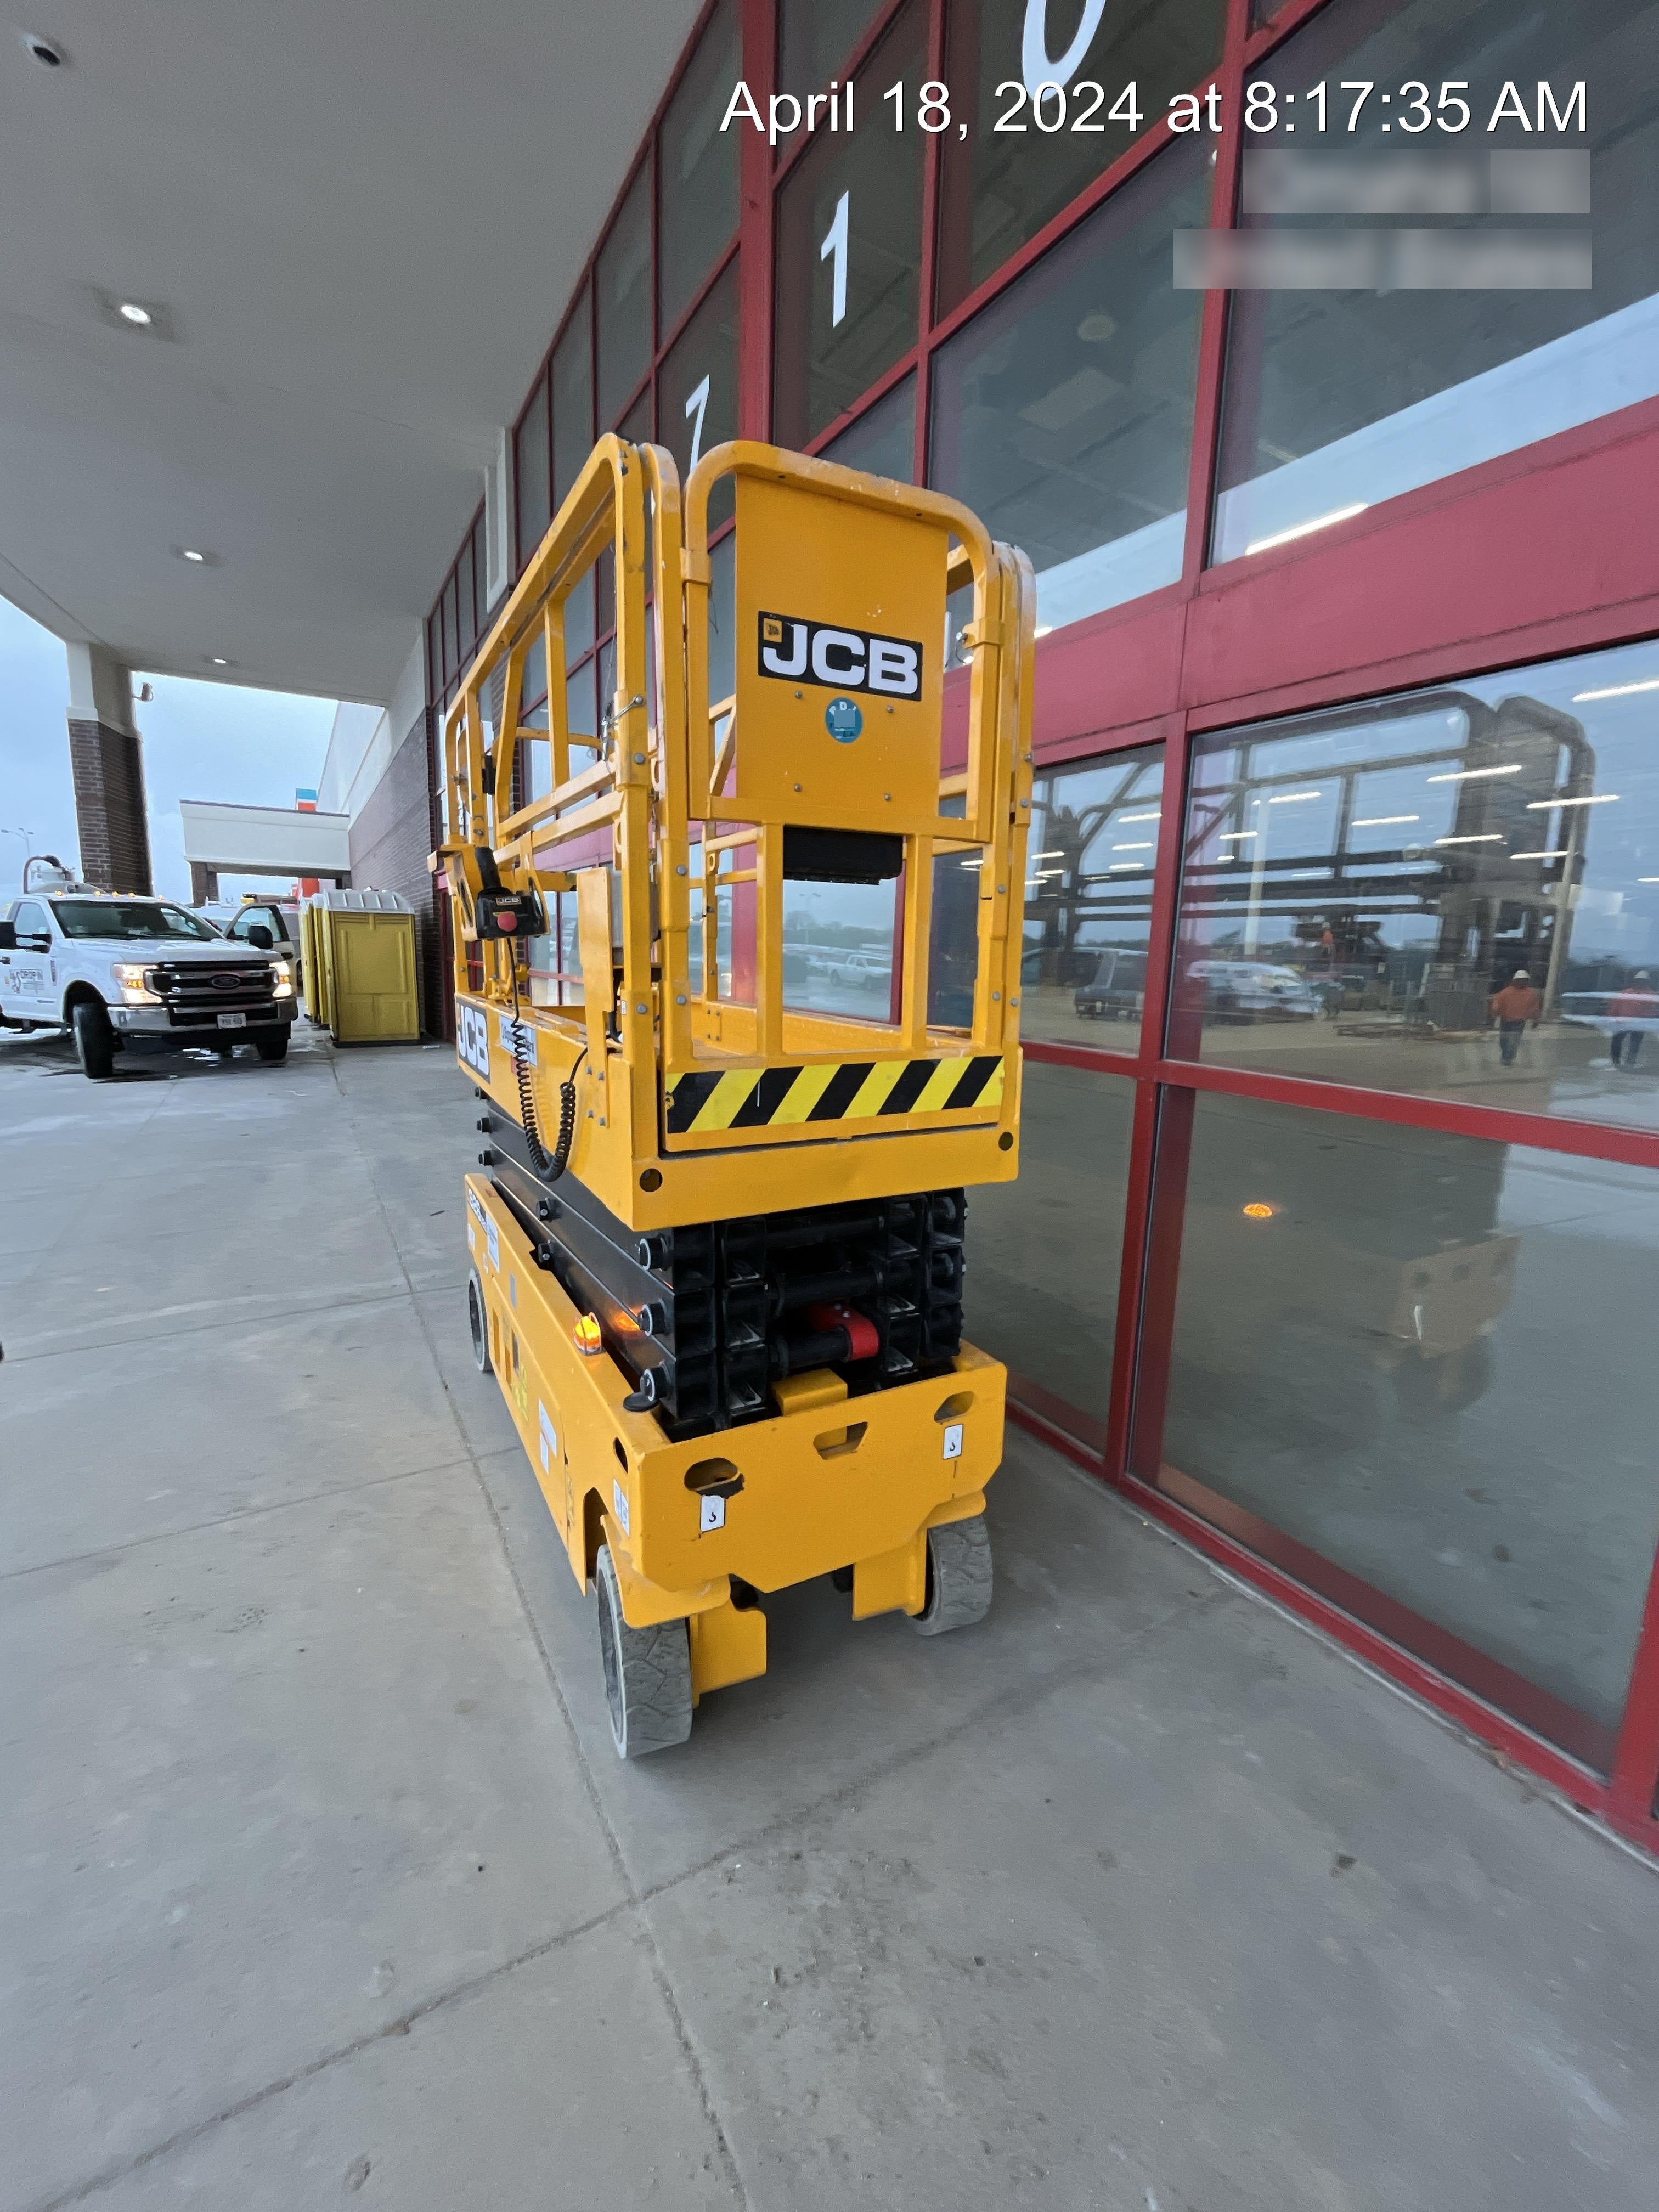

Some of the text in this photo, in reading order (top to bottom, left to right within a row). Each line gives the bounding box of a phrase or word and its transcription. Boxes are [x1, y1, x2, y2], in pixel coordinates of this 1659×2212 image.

[821, 190, 849, 328] 1
[763, 623, 918, 695] JCB
[458, 1005, 489, 1075] JCB
